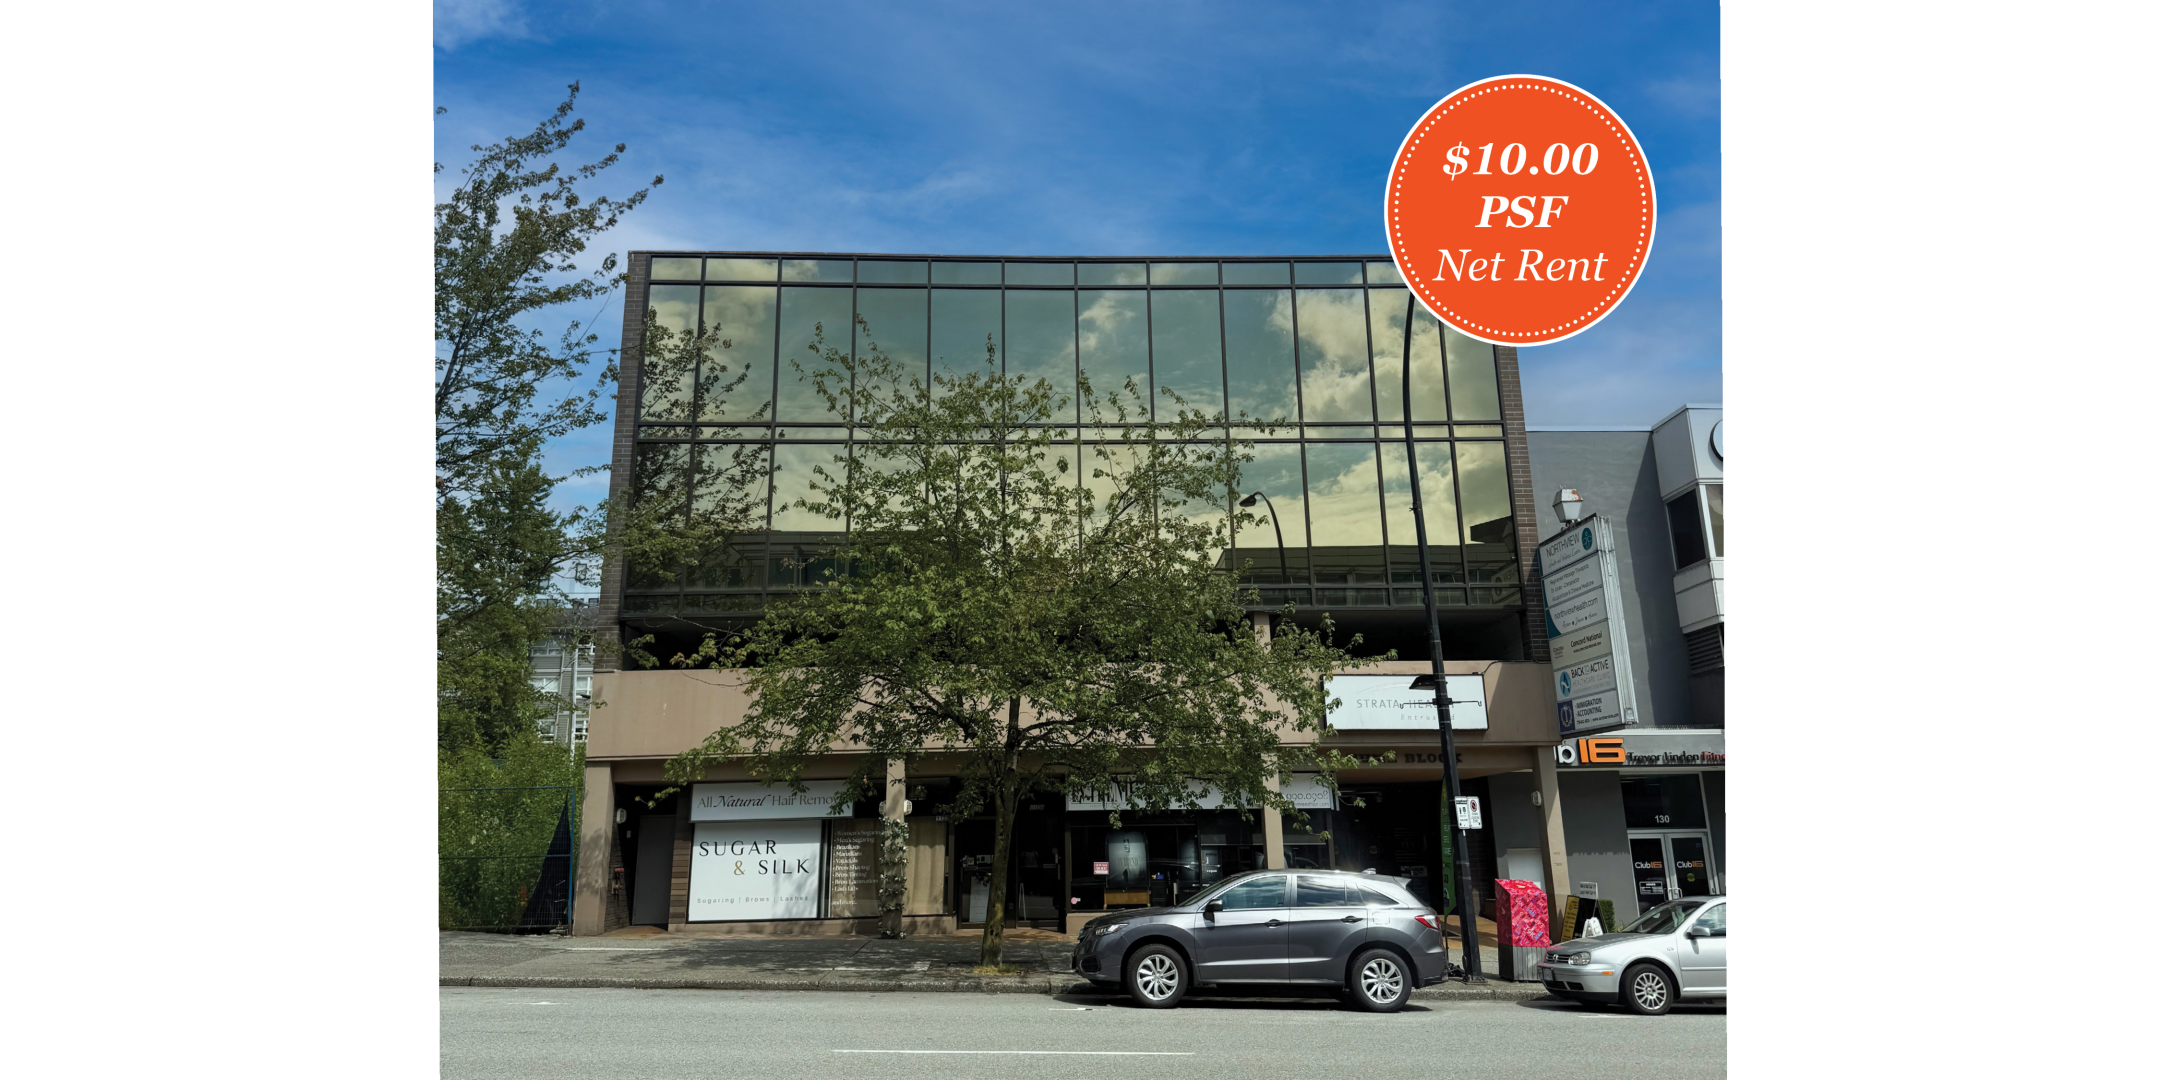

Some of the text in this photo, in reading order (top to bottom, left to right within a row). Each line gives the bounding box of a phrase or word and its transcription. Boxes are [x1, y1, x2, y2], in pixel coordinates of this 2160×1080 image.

[1546, 532, 1580, 558] NORTHVIEW
[1570, 631, 1603, 648] Concord National
[1356, 699, 1400, 709] STRATA
[1628, 751, 1662, 762] Trevor
[697, 794, 840, 808] All Natural Hair Remov
[1654, 814, 1670, 824] 130
[699, 839, 777, 857] SUGAR
[733, 858, 809, 876] & SILK
[1634, 861, 1663, 869] Club16
[1676, 860, 1704, 868] Club16
